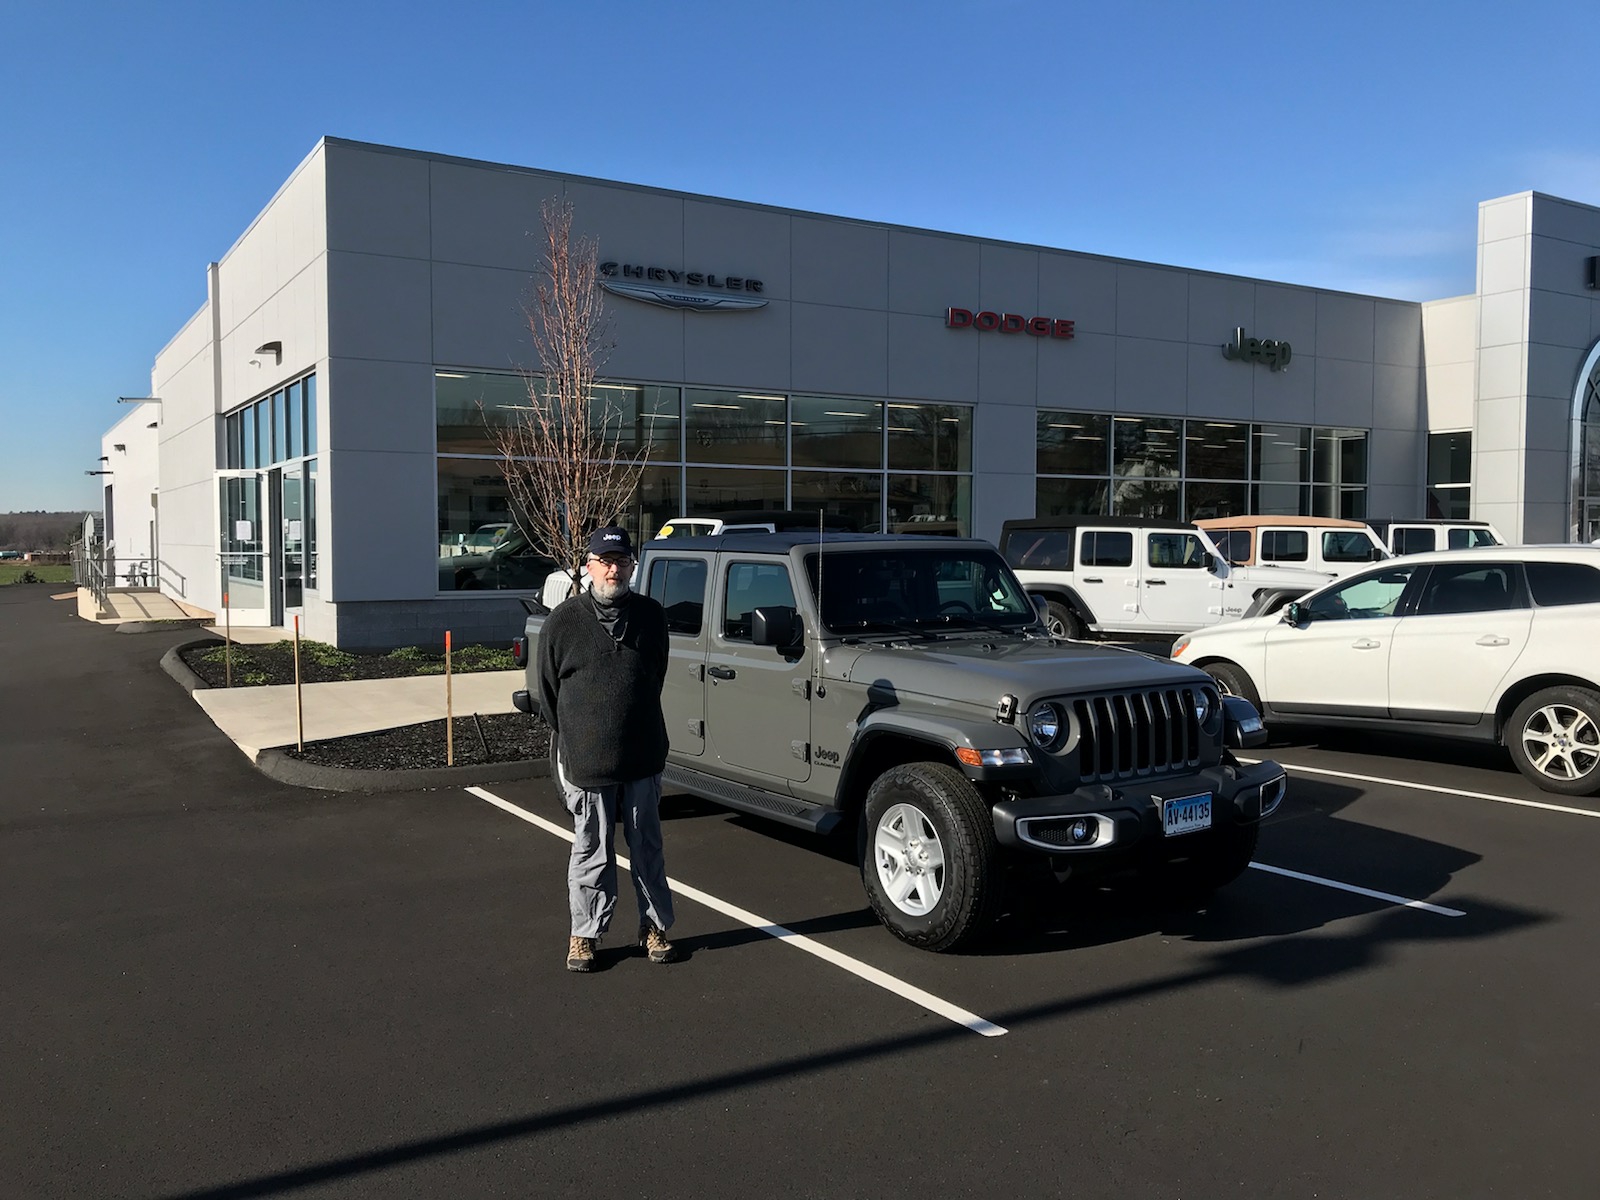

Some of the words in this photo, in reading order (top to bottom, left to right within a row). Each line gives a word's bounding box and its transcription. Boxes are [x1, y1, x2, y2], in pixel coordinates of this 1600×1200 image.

[600, 261, 764, 293] CHRYSLER
[945, 307, 1075, 339] DODGE
[1222, 326, 1291, 372] Jeep
[602, 533, 622, 541] Jeep
[815, 746, 840, 764] Jeep
